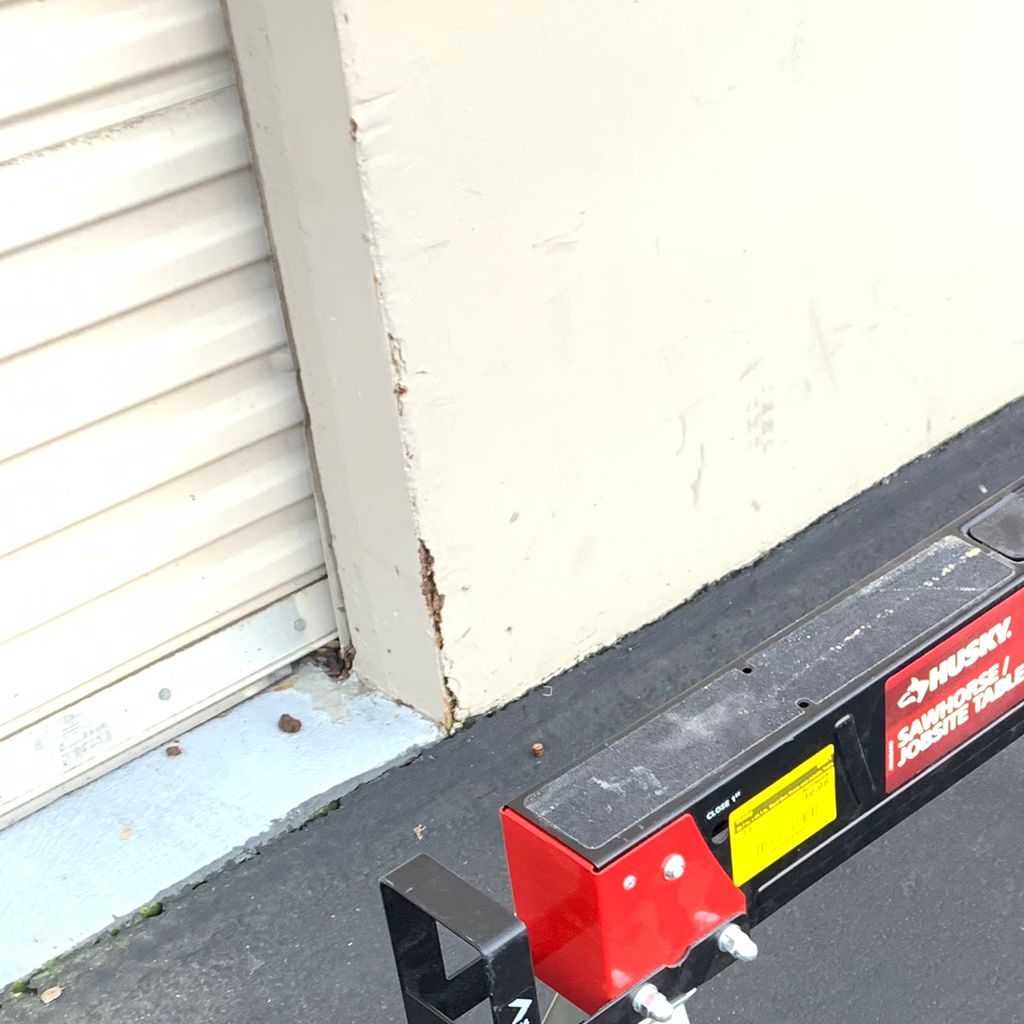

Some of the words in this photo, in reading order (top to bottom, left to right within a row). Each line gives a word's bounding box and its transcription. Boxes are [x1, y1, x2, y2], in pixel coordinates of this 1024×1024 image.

[897, 663, 1000, 748] SAWHORSE
[897, 703, 970, 768] JOBSITE
[706, 799, 731, 820] CLOSE
